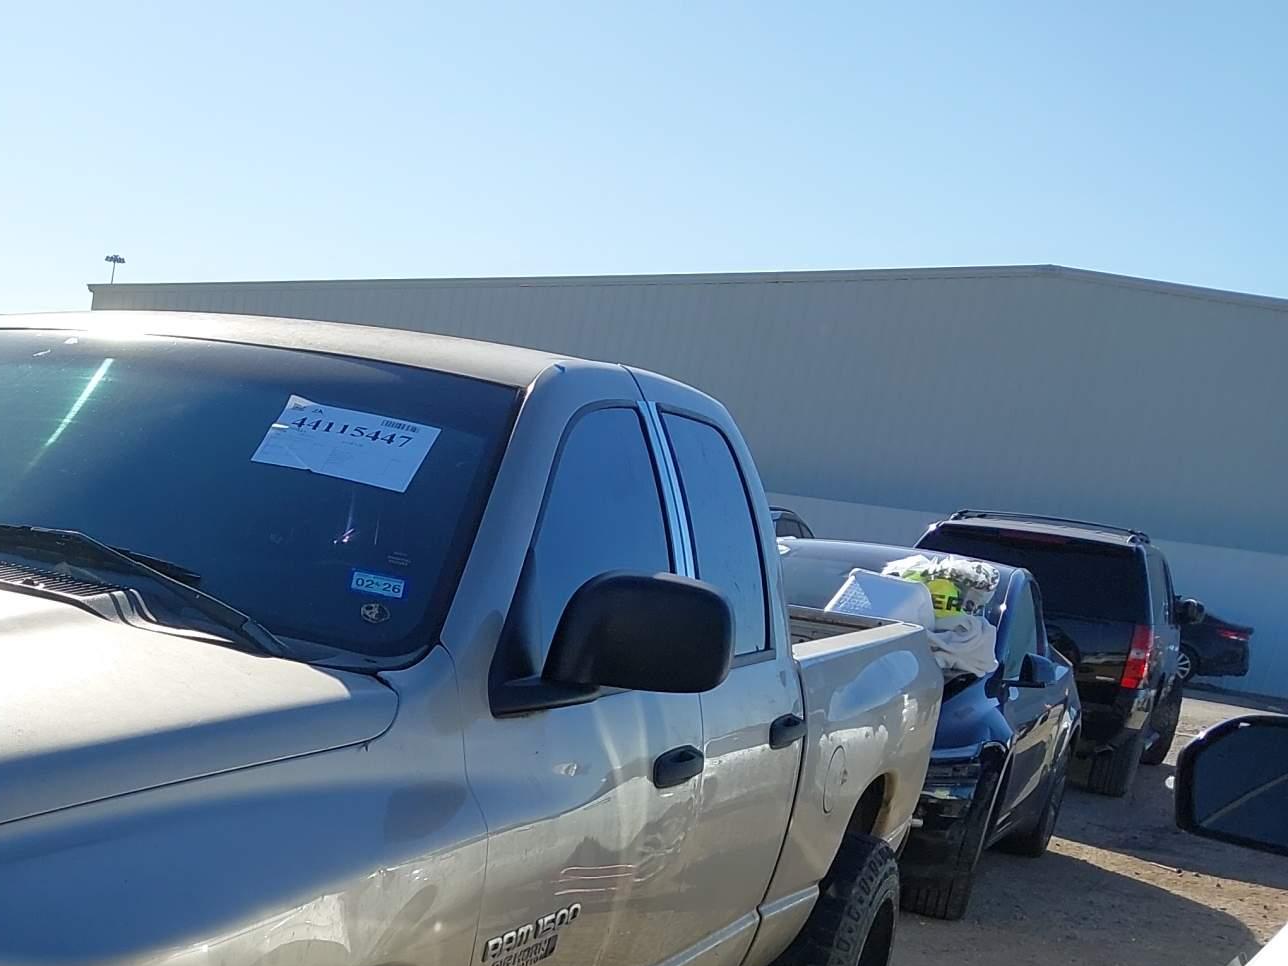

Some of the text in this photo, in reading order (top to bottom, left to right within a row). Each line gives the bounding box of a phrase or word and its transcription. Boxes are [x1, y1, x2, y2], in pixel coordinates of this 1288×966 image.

[291, 415, 414, 448] 44115447
[355, 577, 401, 594] 02 26
[482, 902, 582, 962] RAM 1500
